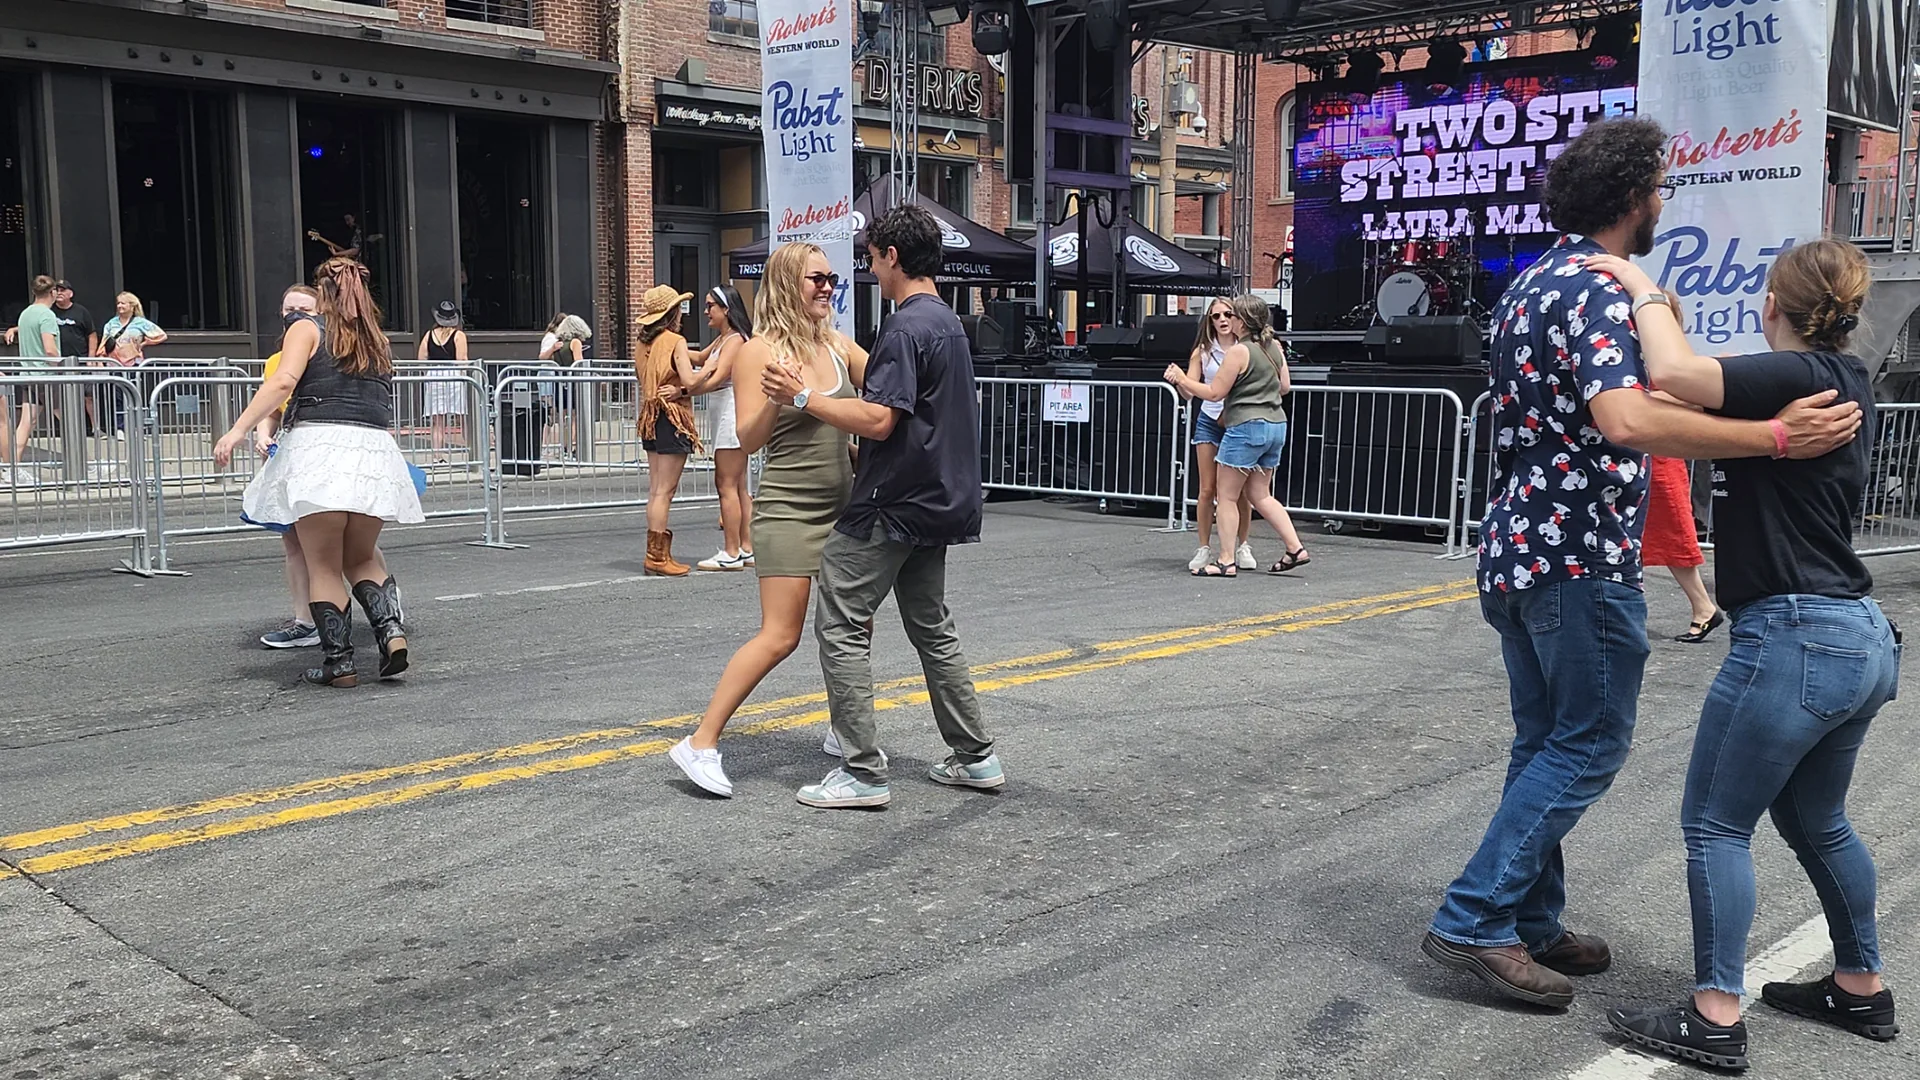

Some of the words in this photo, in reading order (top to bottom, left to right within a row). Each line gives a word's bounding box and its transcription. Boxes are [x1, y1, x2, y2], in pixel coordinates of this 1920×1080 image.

[766, 0, 837, 45] Robert's
[1672, 10, 1782, 60] Light
[804, 38, 840, 50] WORLD
[1667, 64, 1734, 84] merica's
[1738, 58, 1798, 78] Quality
[1728, 80, 1766, 96] Beer
[767, 80, 844, 130] Pabst
[1396, 100, 1517, 153] TWO
[1666, 108, 1803, 171] Robert's
[780, 130, 837, 162] Light
[1340, 146, 1536, 203] STREET
[1738, 166, 1802, 182] WORLD
[777, 195, 849, 233] Robert's
[1362, 208, 1475, 241] LAURA
[1485, 203, 1560, 236] MA
[943, 262, 992, 275] #TPGLIVE
[1050, 402, 1061, 411] PIT
[1062, 402, 1083, 411] AREA
